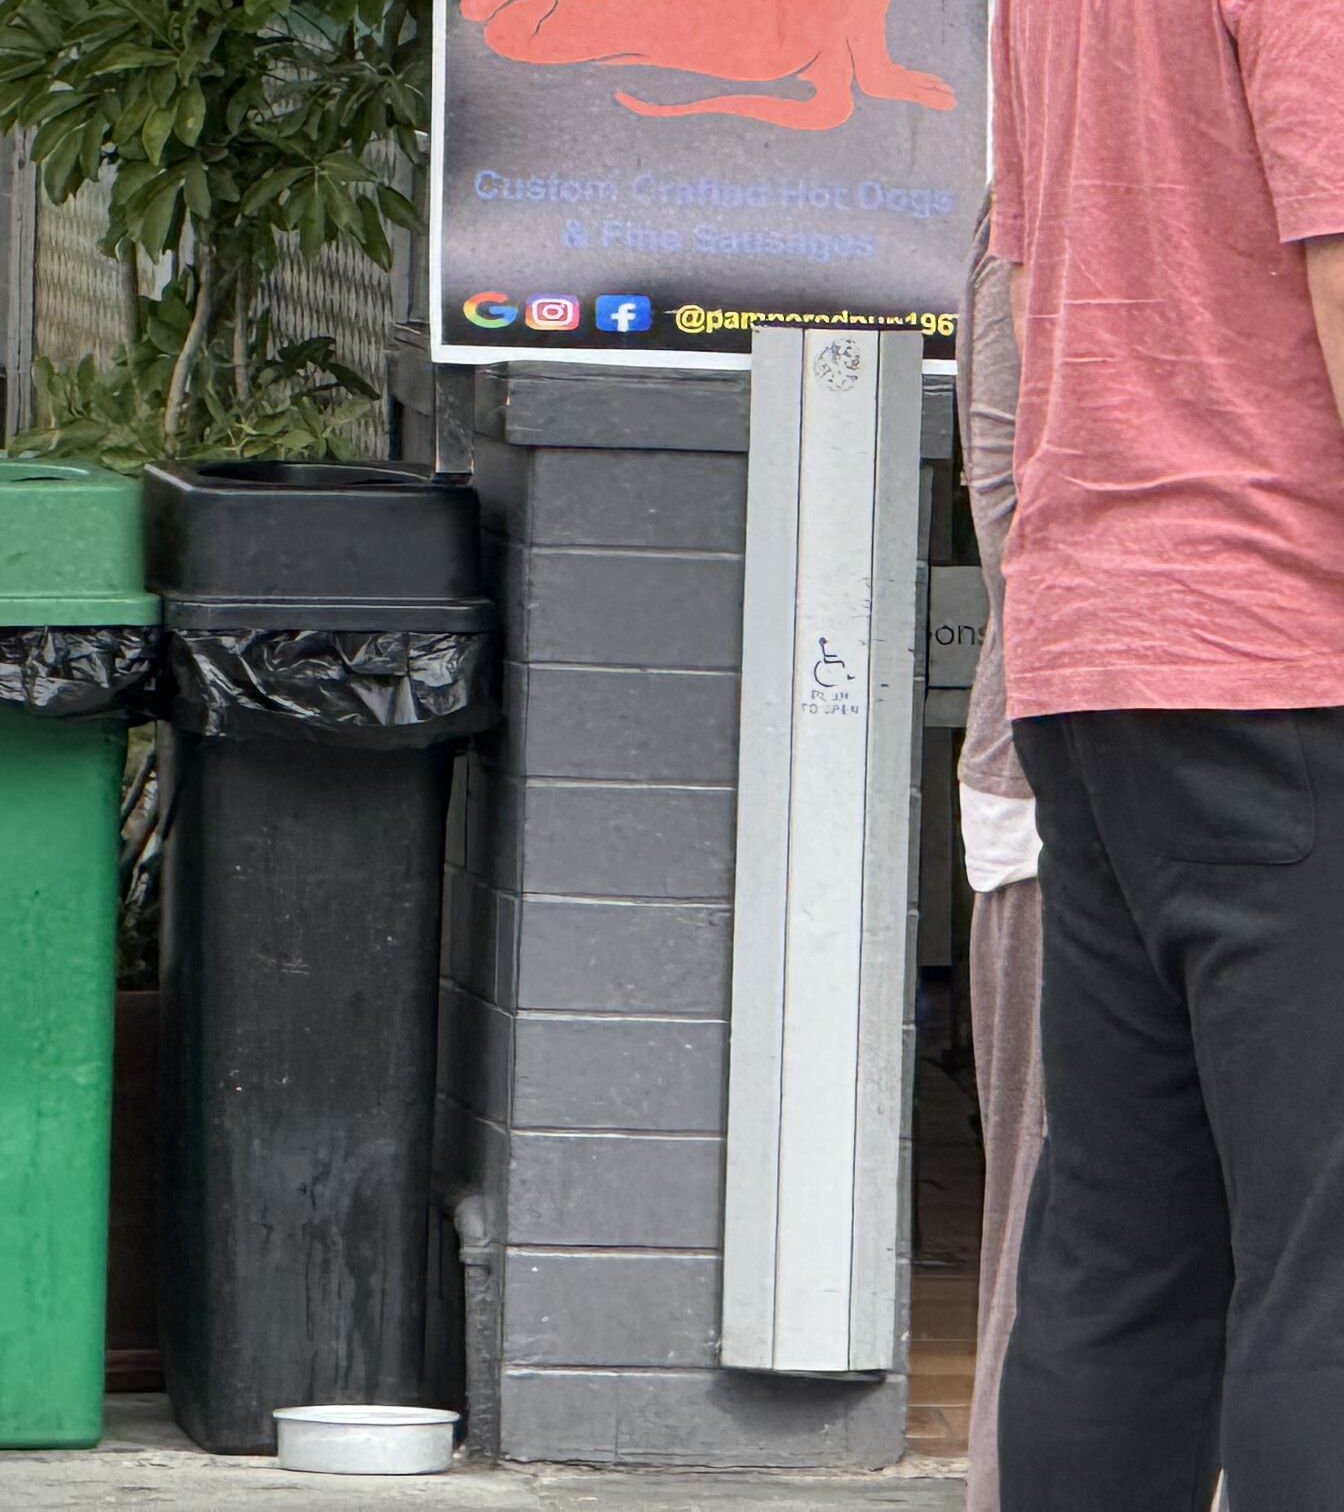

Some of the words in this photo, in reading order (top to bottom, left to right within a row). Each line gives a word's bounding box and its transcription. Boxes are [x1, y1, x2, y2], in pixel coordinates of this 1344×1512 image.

[474, 169, 617, 202] Custom
[859, 182, 955, 219] Dogs
[562, 219, 586, 250] &
